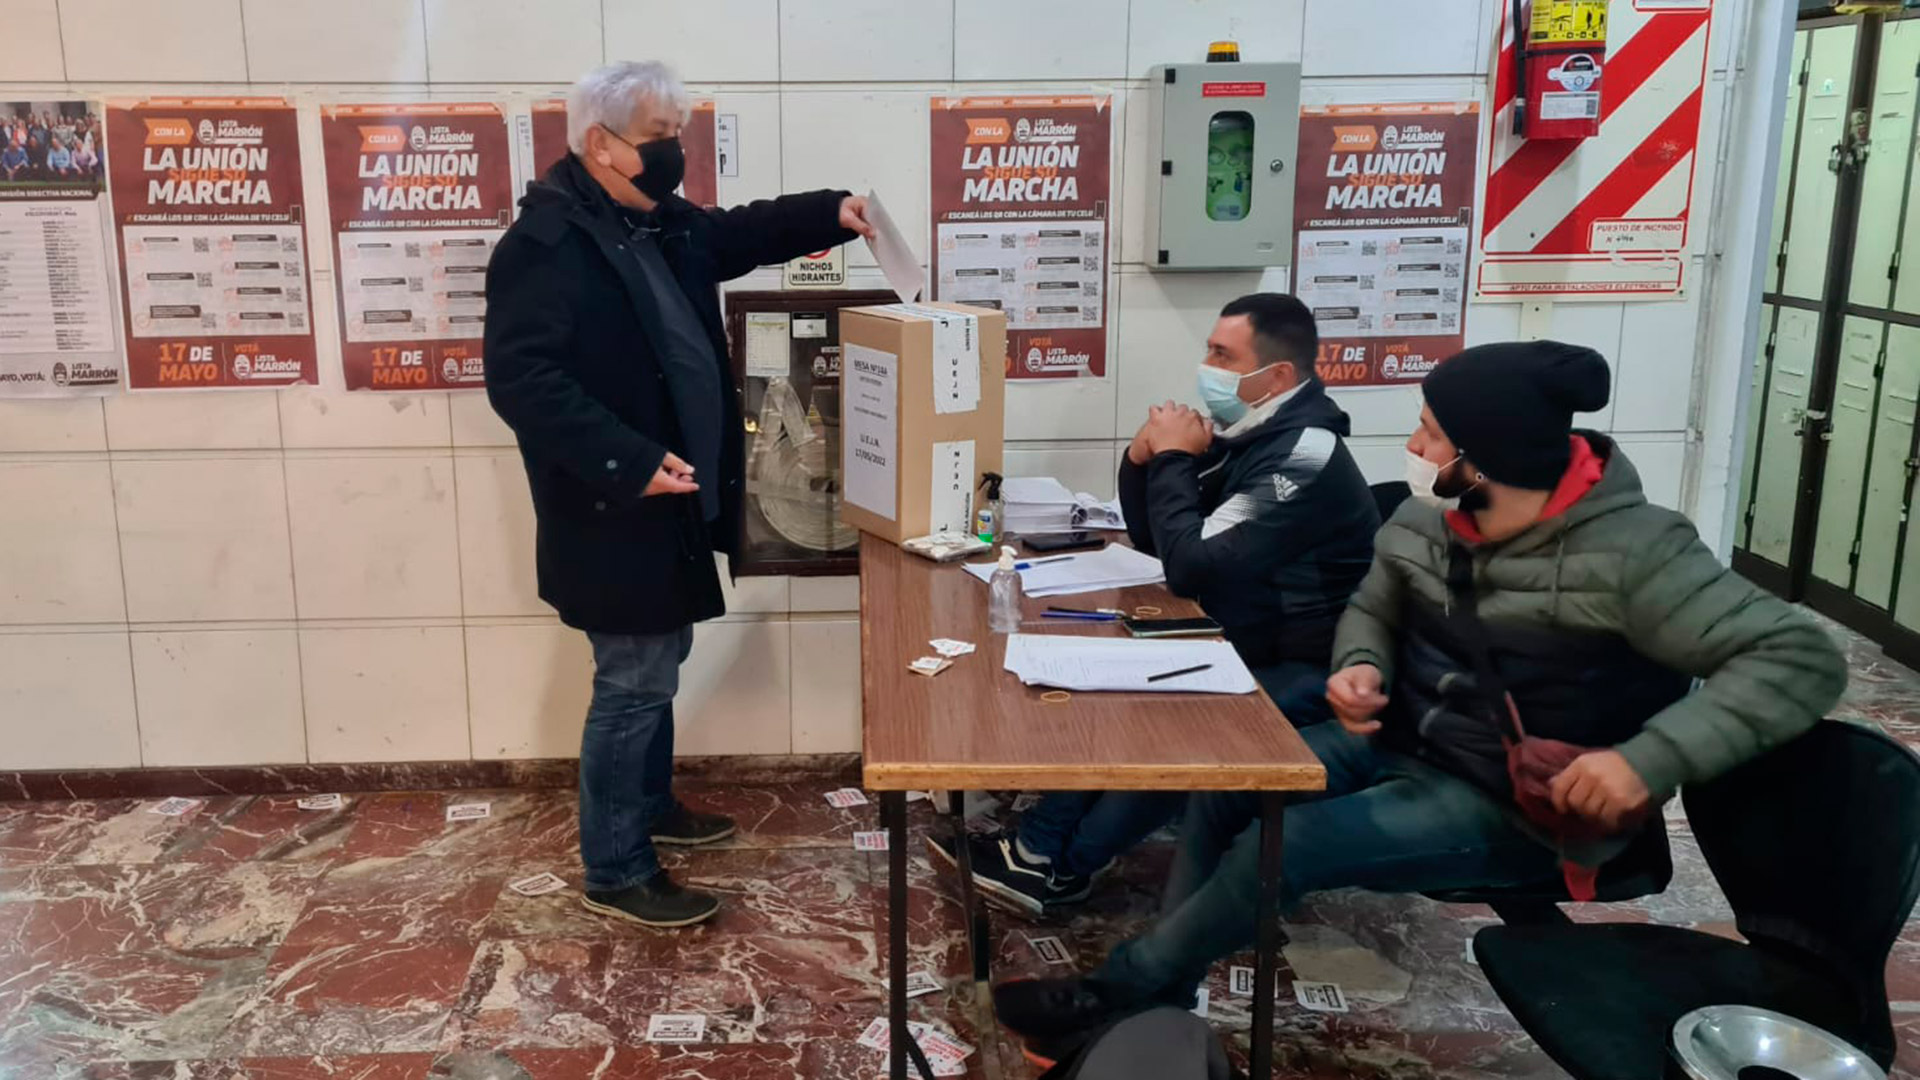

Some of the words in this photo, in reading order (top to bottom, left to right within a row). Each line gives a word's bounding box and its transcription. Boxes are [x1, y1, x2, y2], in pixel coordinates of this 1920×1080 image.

[218, 120, 238, 128] LISTA
[430, 126, 449, 134] LISTA
[1034, 124, 1076, 136] MARRÓN
[218, 125, 263, 137] MARRÓN
[430, 131, 474, 143] MARRÓN
[1400, 130, 1445, 143] MARRÓN
[143, 148, 177, 171] LA
[182, 144, 268, 171] UNIÓN
[962, 146, 993, 170] LA
[998, 140, 1080, 168] UNIÓN
[358, 154, 392, 178] LA
[396, 149, 478, 176] UNIÓN
[1326, 154, 1358, 177] LA
[1363, 148, 1446, 175] UNIÓN
[168, 168, 219, 182] SIGUE
[984, 166, 1031, 180] SIGUE
[382, 175, 431, 188] SIGUE
[1348, 174, 1397, 187] SIGUE
[148, 180, 272, 204] MARCHA
[962, 177, 1078, 202] MARCHA
[362, 186, 482, 211] MARCHA
[1325, 184, 1443, 210] MARCHA
[800, 262, 833, 271] NICHOS
[792, 273, 841, 281] HIDRANTES
[159, 343, 187, 362] 17
[189, 346, 213, 361] DE
[255, 354, 275, 362] LISTA
[372, 348, 398, 366] 17
[401, 351, 422, 365] DE
[1046, 353, 1090, 365] MARRÓN
[1316, 344, 1341, 362] 17
[1343, 347, 1365, 361] DE
[1403, 355, 1423, 363] LISTA
[254, 360, 301, 372] MARRÓN
[854, 360, 869, 370] MESA
[1314, 363, 1367, 380] MAYO
[71, 367, 118, 379] MARRÓN
[159, 363, 218, 382] MAYO
[372, 367, 427, 384] MAYO
